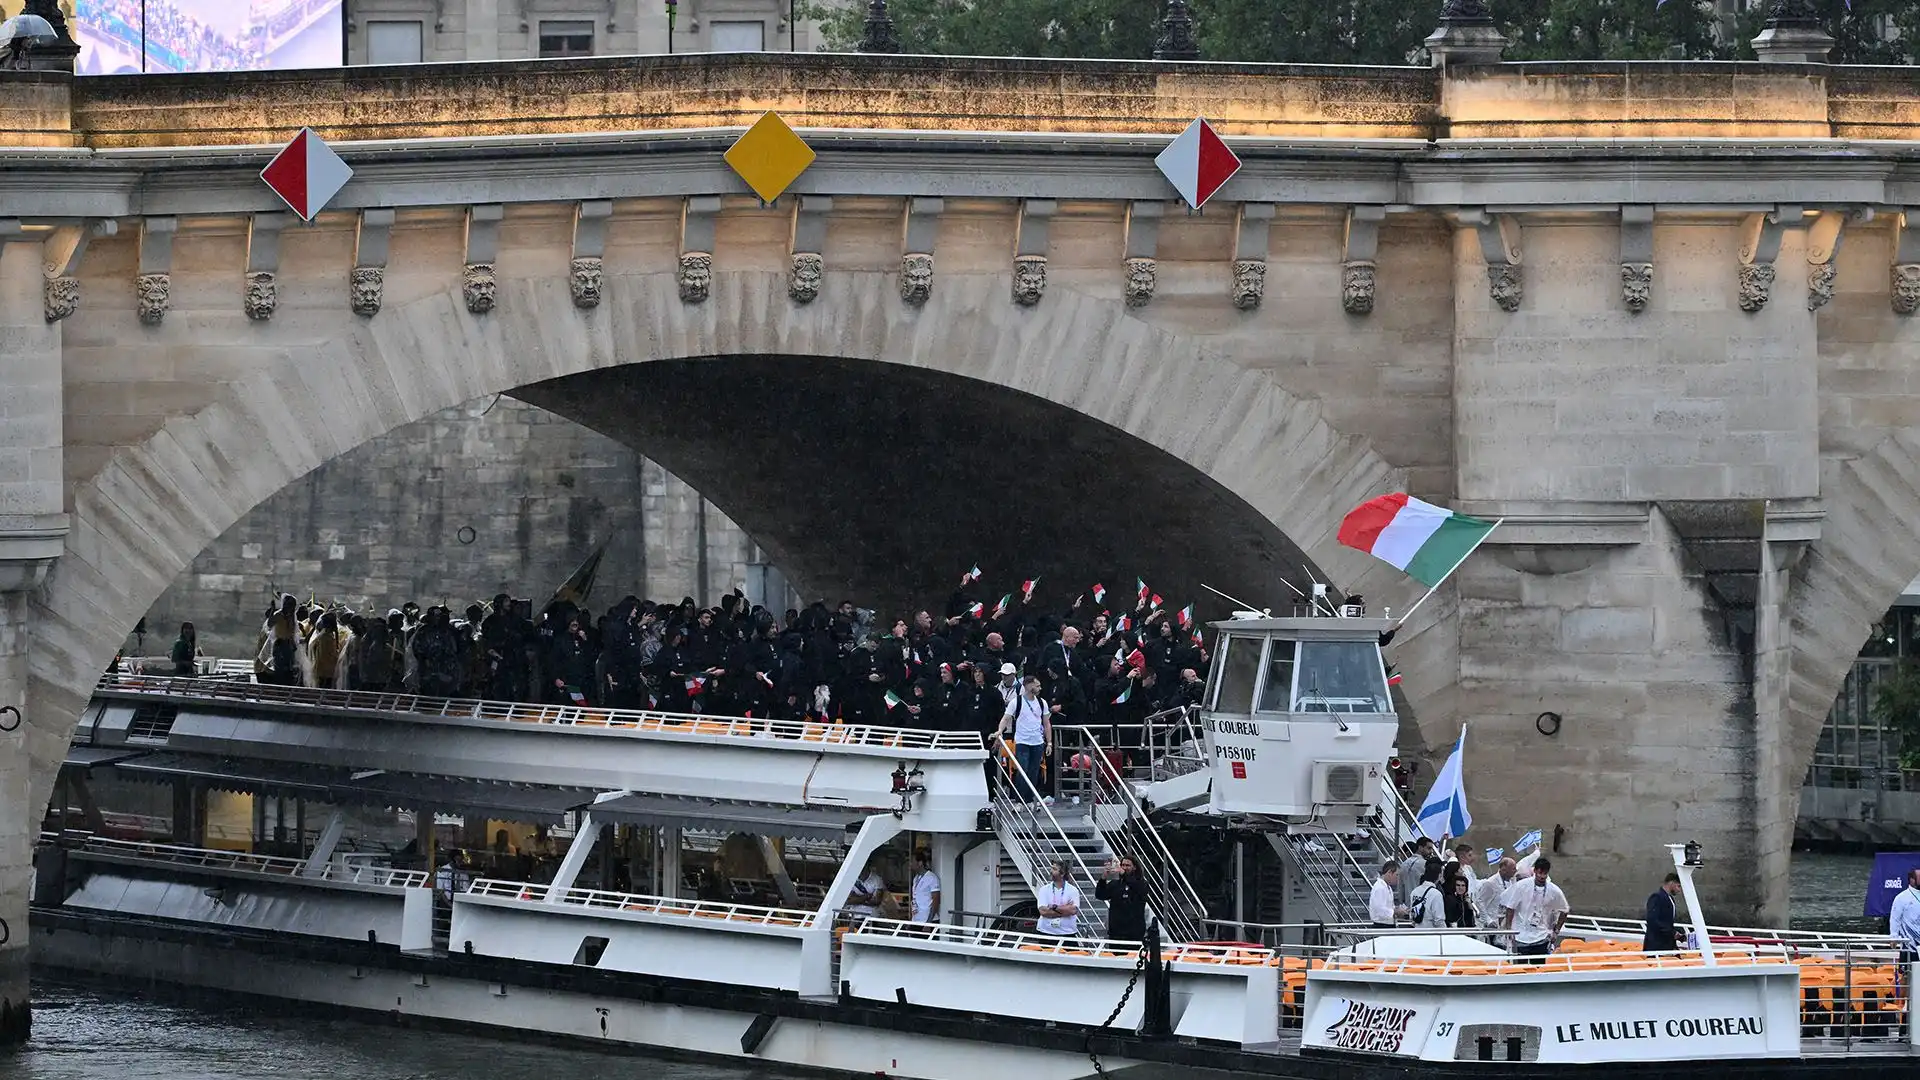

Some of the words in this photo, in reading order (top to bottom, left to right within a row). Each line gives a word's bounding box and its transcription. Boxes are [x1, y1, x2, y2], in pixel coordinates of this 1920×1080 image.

[1219, 720, 1260, 736] COUREAU
[1215, 745, 1257, 761] P15810F
[1347, 1000, 1415, 1031] BATEAUX
[1436, 1022, 1455, 1037] 37
[1556, 1024, 1584, 1043] LE
[1589, 1020, 1658, 1040] MULET
[1665, 1016, 1764, 1037] COUREAU
[1337, 1028, 1403, 1053] MOUCHES
